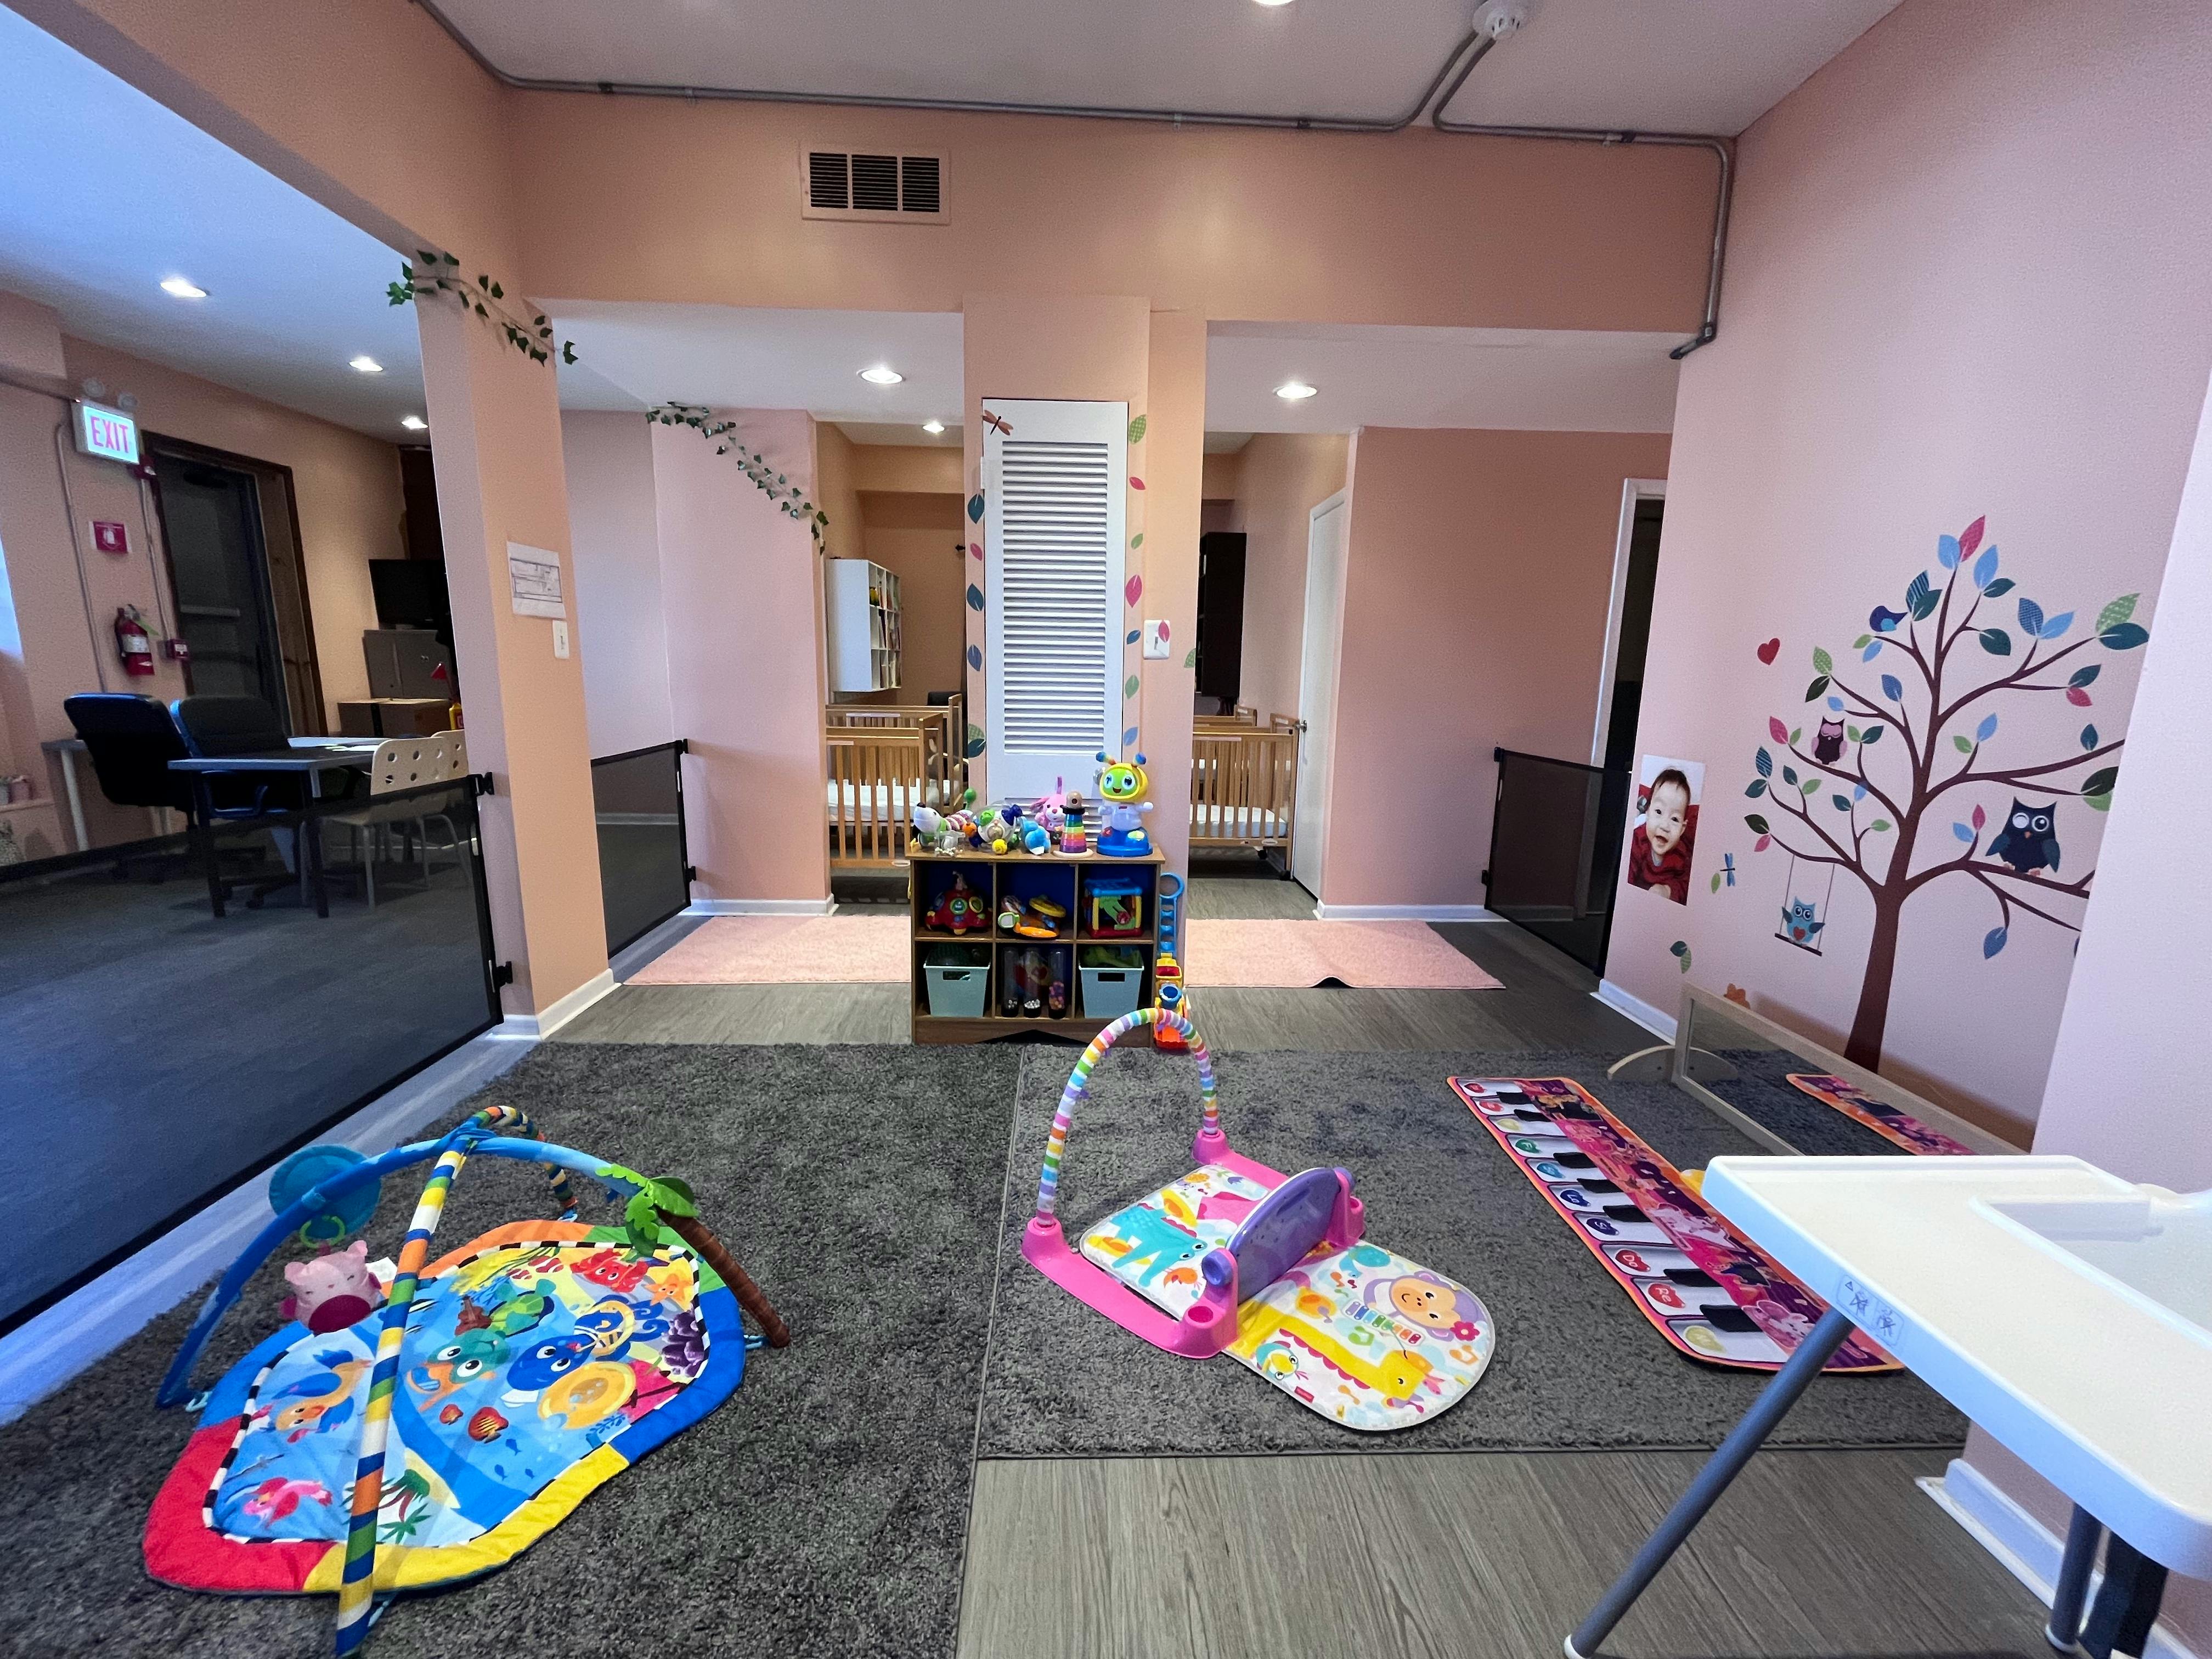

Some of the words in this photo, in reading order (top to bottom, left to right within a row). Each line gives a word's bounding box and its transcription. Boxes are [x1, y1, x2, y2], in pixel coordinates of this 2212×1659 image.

[91, 416, 129, 453] EXIT
[1567, 1194, 1580, 1203] La
[1622, 1254, 1638, 1268] Do
[1655, 1287, 1672, 1302] Re
